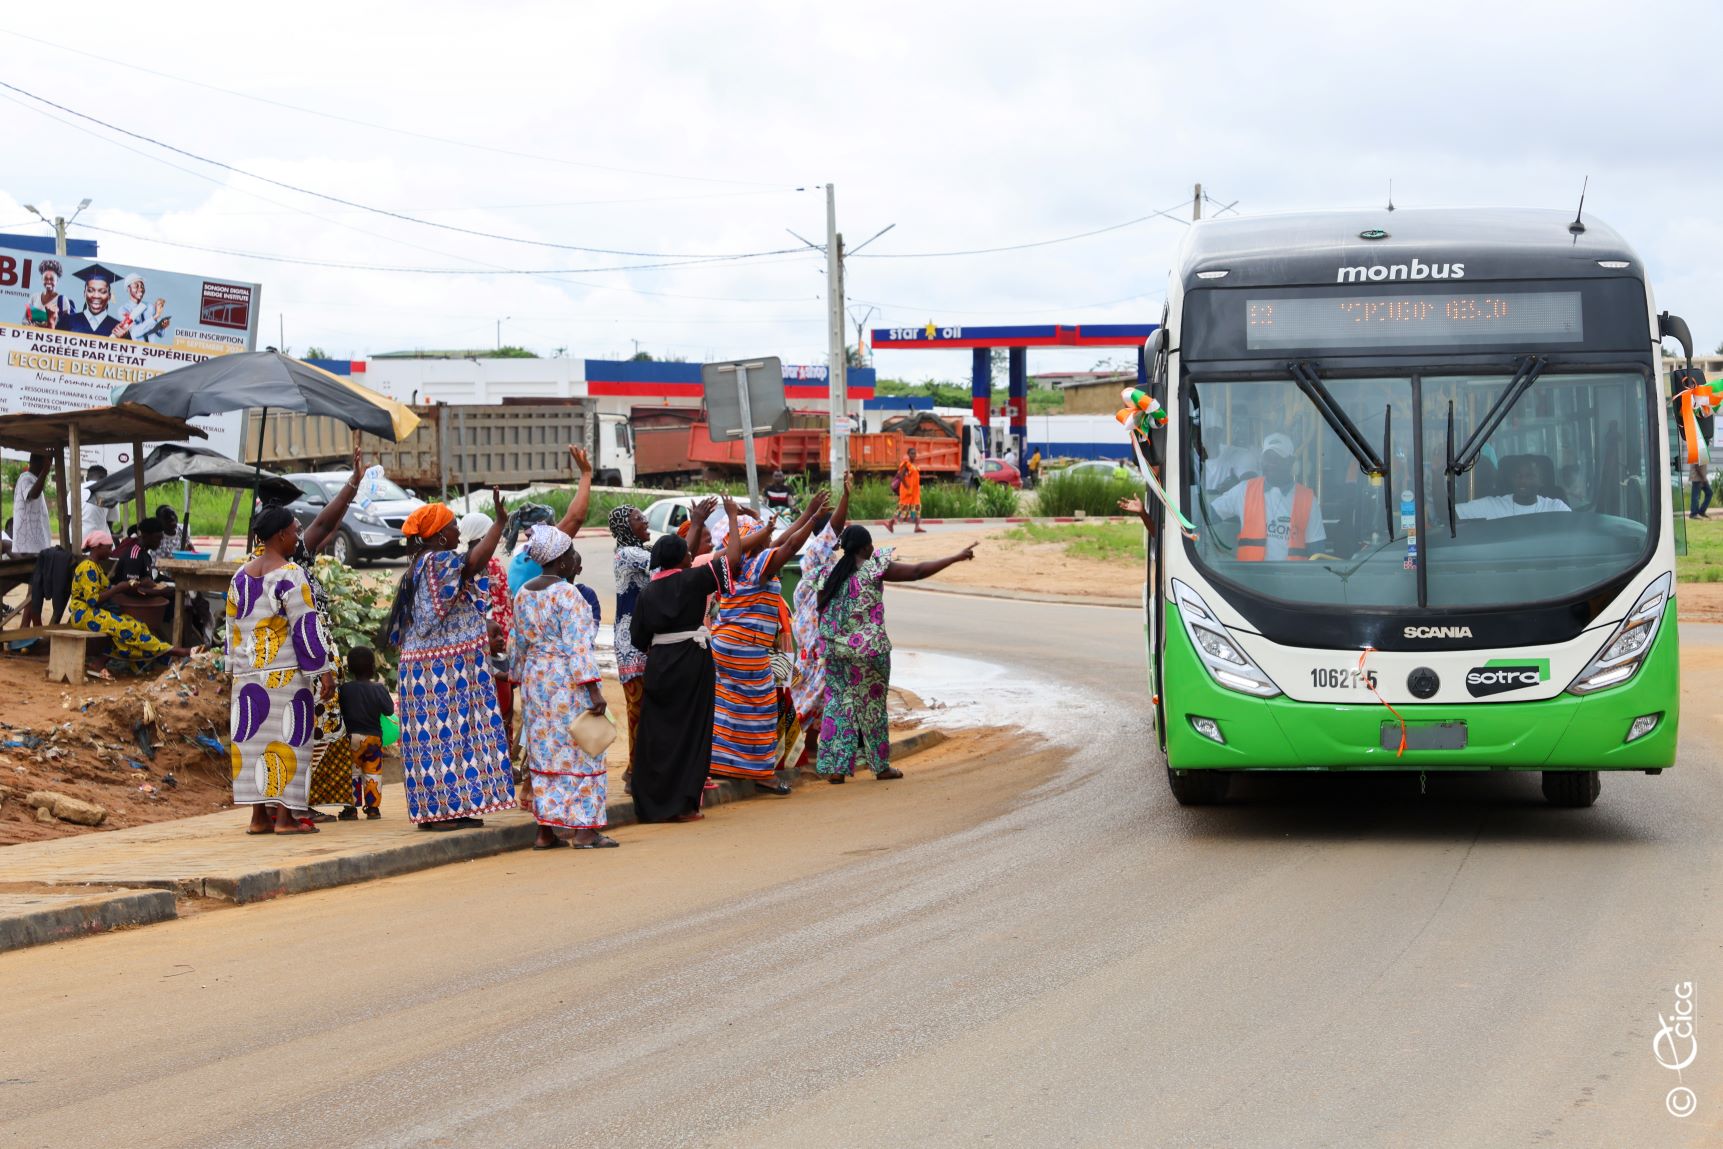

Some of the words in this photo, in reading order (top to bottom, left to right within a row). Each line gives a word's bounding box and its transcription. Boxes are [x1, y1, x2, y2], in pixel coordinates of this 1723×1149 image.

[1337, 259, 1465, 283] monbus
[4, 290, 30, 298] INSTITUTE
[203, 290, 223, 299] BRIDGE
[224, 293, 249, 302] INSTITUTE
[204, 284, 230, 294] SONGON
[230, 287, 249, 295] DIGITAL
[175, 329, 198, 339] DEBUT
[199, 332, 244, 345] INSCRIPTION
[889, 328, 919, 340] star
[942, 326, 962, 339] oil
[12, 329, 137, 354] D'ENSEIGNEMENT
[31, 343, 79, 358] AGRÉÉE
[82, 350, 105, 361] PAR
[108, 352, 146, 367] L'ÉTAT
[8, 351, 65, 373] L'ECOLE
[71, 361, 97, 377] DES
[103, 365, 161, 384] METIER
[36, 372, 56, 383] Nous
[59, 375, 94, 388] Formons
[24, 386, 59, 396] RESSOURCES
[23, 395, 50, 404] FINANCES
[23, 402, 62, 411] D'ENTREPRISES
[1404, 626, 1473, 638] SCANIA
[1310, 668, 1378, 691] 10621-5
[1467, 670, 1540, 685] sotra
